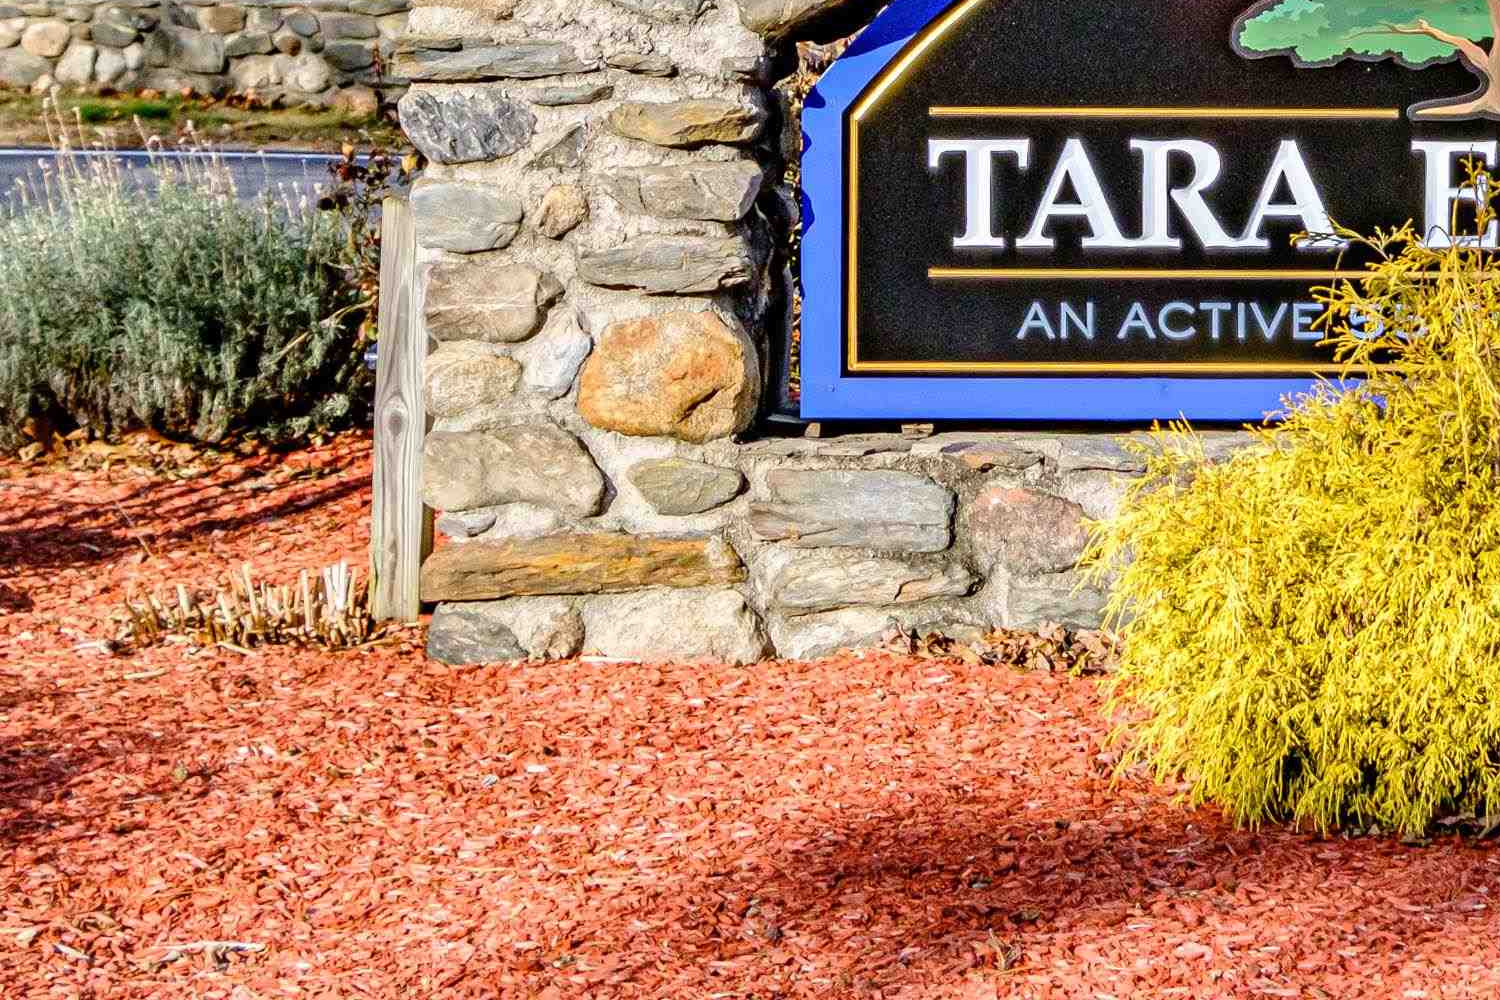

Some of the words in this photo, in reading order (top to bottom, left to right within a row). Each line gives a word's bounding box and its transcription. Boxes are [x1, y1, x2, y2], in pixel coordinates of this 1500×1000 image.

[928, 137, 1350, 249] TARA
[1016, 301, 1095, 340] AN
[1116, 301, 1325, 340] ACTIVE
